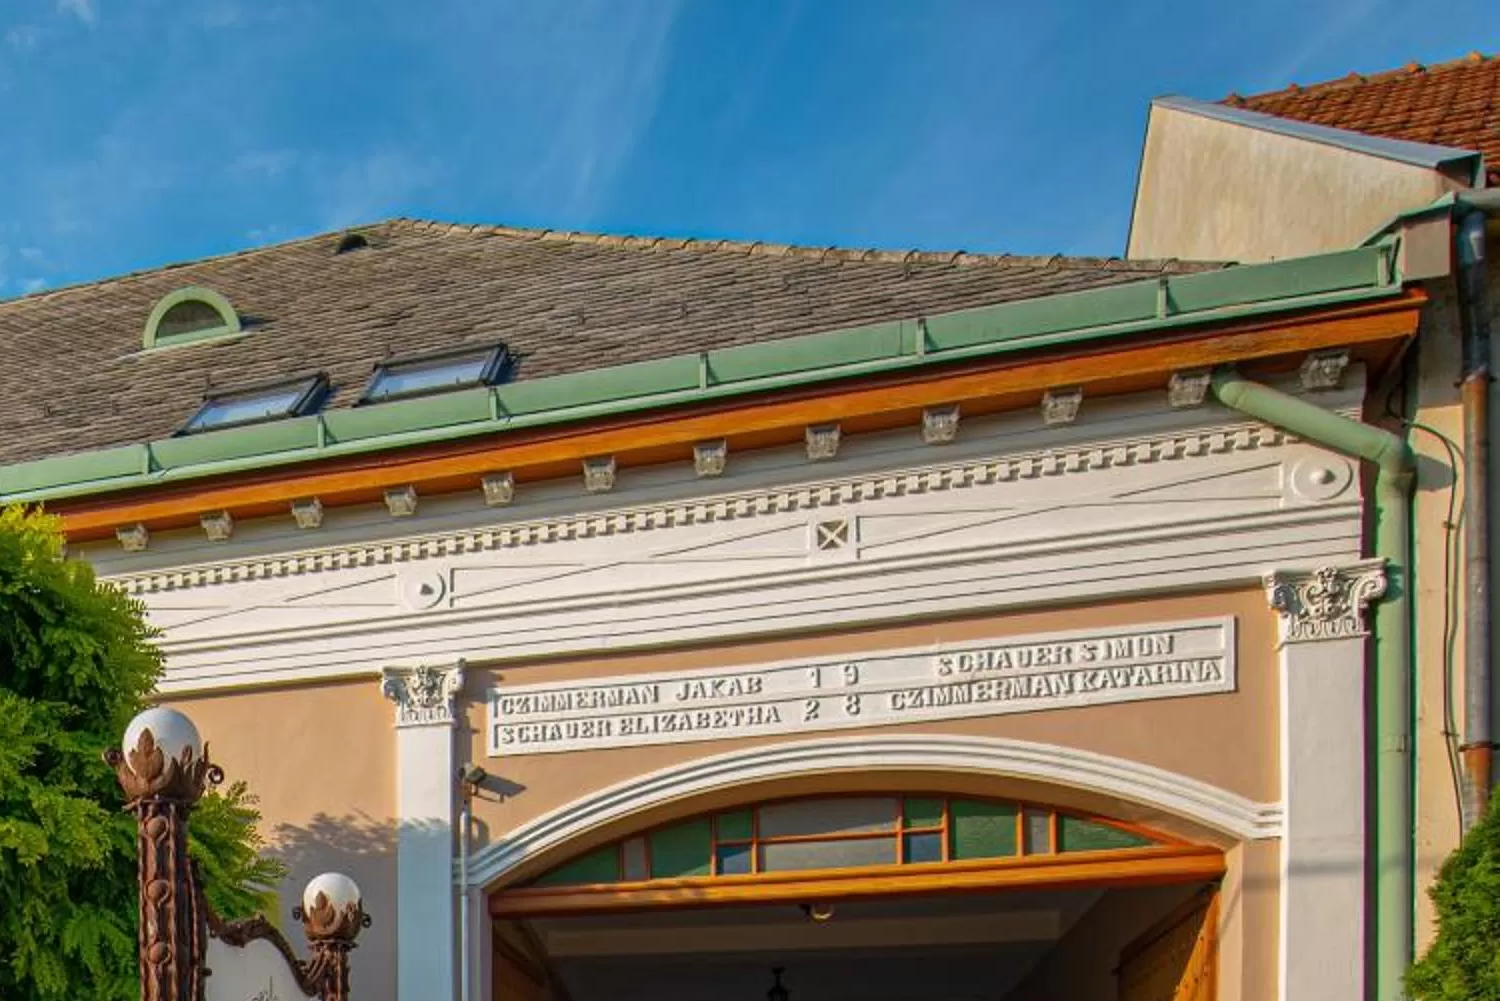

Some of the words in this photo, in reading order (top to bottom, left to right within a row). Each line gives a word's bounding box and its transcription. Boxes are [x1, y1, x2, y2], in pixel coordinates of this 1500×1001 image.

[501, 685, 660, 715] CZIMMERMAN
[676, 677, 763, 701] JAKAB
[501, 719, 612, 745] SCHAUER
[617, 706, 783, 736] ELIZABETHA
[890, 671, 1076, 711] CZIMMERMAN
[1077, 659, 1223, 693] KATARINA
